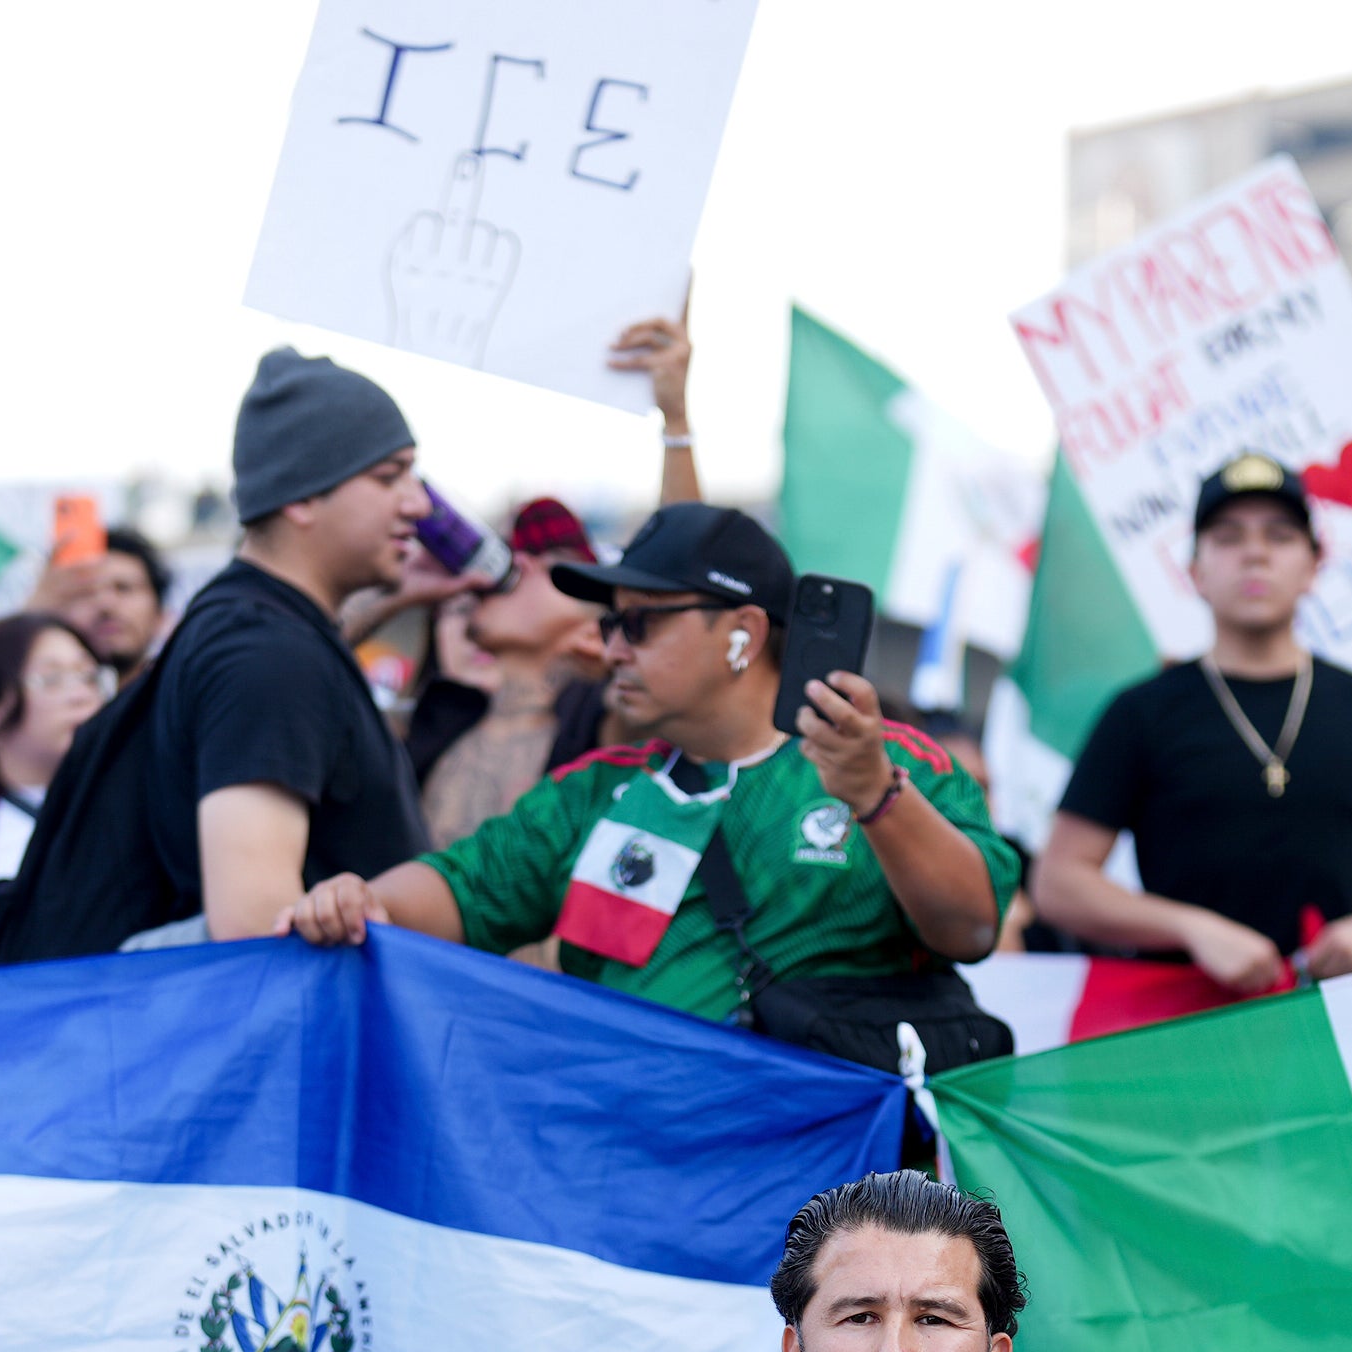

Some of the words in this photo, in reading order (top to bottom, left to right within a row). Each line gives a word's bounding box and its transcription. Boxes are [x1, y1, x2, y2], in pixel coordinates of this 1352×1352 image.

[333, 26, 652, 192] ICE
[174, 1309, 195, 1338] DE
[185, 1276, 210, 1300] EL
